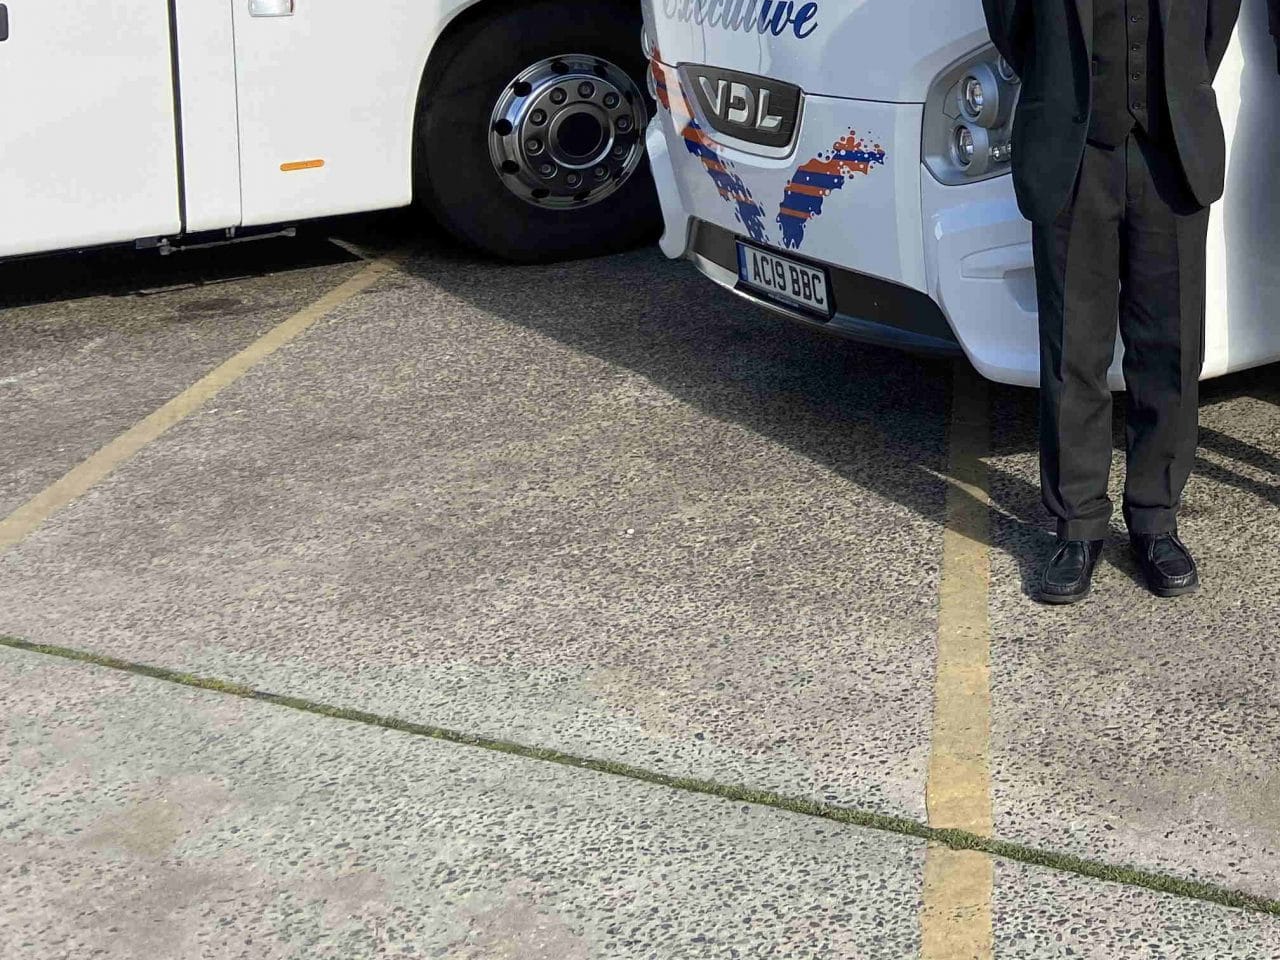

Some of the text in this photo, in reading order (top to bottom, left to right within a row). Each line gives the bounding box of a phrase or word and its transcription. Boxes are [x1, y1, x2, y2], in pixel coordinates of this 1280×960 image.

[698, 75, 783, 133] VDL
[753, 252, 825, 305] AC19 BBC
